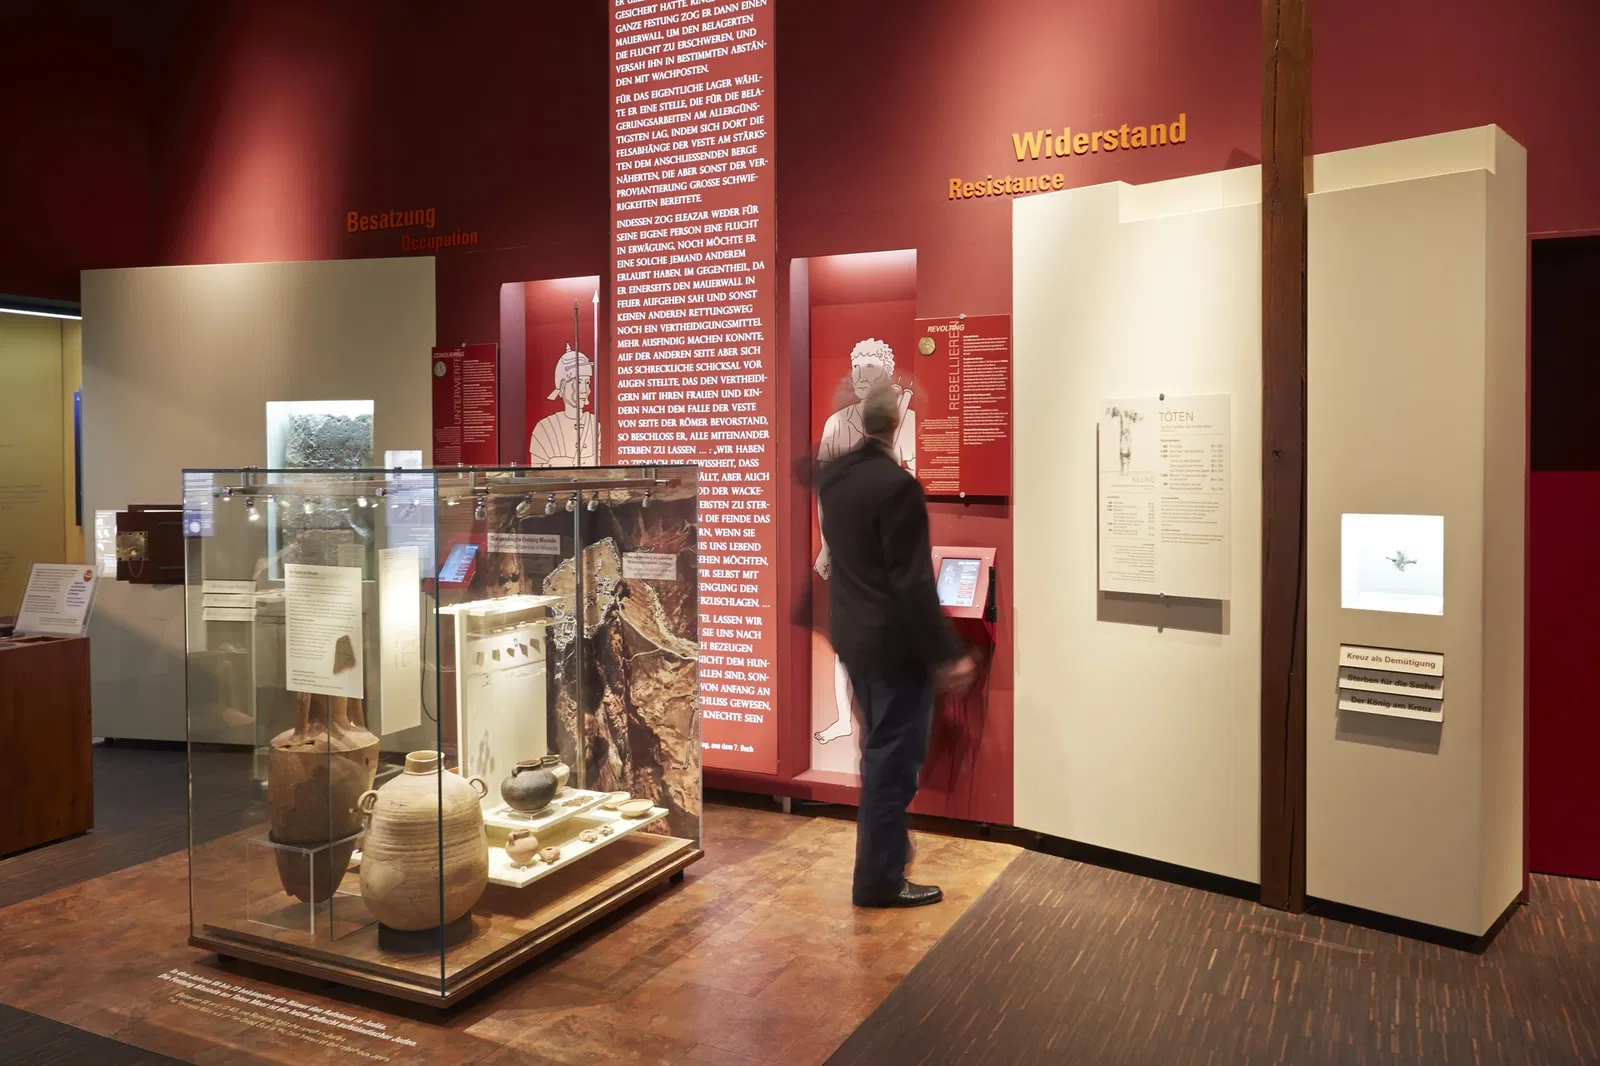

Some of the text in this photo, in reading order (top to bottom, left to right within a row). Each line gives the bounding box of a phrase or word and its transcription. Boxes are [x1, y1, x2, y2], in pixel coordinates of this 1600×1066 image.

[615, 0, 688, 19] GESICHERT HATTE.
[616, 14, 753, 47] MAUERWALL, UM DEN BELAGERTEN
[616, 40, 767, 73] VERSAH IHN IN BESTIMMTEN ABSTÄN-
[616, 74, 762, 104] FÜR DAS EIGENTLICHE LAGER WÄHL-
[616, 102, 760, 130] GERUNGSARBEITEN AM ALLERGÜNS-
[616, 130, 767, 157] FELSABHÄNGE DER VESTE AM STÄRKS-
[1012, 113, 1186, 161] Widerstand
[617, 158, 768, 184] NÄHERTEN, DIE ABER SONST DER VER-
[949, 172, 1064, 200] Resistance
[617, 194, 702, 211] RIGKEITEN BEREITETE.
[347, 208, 435, 232] Besatzung
[617, 219, 758, 242] SEINE EIGENE PERSON EINE FLUCHT
[402, 230, 478, 252] Occupation
[617, 249, 746, 268] EINE SOLCHE JEMAND ANDEREM
[629, 283, 671, 293] EINERSEITS
[674, 282, 690, 290] DEN
[693, 277, 743, 289] MAUERWALL
[746, 276, 755, 284] IN
[618, 304, 753, 321] KEINEN ANDEREN RETTUNGSWEG
[928, 324, 964, 332] REVOLTING
[618, 332, 764, 348] MEHR AUSFINDIG MACHEN KONNTE,
[618, 360, 762, 374] DAS SCHRECKLICHE SCHICKSAL VOR
[618, 388, 762, 401] GERN MIT IHREN FRAUEN UND KIN-
[638, 419, 659, 427] SEITE
[680, 417, 708, 426] RÖMER
[710, 416, 768, 426] BEVORSTAND,
[1159, 410, 1194, 422] TÖTEN
[618, 446, 651, 454] STERBEN
[668, 446, 696, 454] LASSEN
[714, 445, 733, 454] „WIR
[736, 444, 764, 453] HABEN
[732, 487, 763, 495] WACKE-
[706, 514, 770, 523] DIE FEINDE DAS
[714, 528, 755, 537] WENN SIE
[710, 542, 761, 551] UNS LEBEND
[723, 555, 768, 566] MÖCHTEN,
[712, 570, 759, 579] SELBST MIT
[714, 615, 762, 625] LASSEN WIR
[702, 628, 761, 639] SIE UNS NACH
[710, 642, 752, 652] BEZEUGEN
[1347, 652, 1369, 661] Kreuz
[1385, 656, 1436, 669] Demütigung
[700, 683, 770, 695] VON ANFANG AN
[1347, 674, 1379, 684] Sterben
[1410, 682, 1435, 690] Sache
[730, 699, 771, 710] GEWESEN,
[1367, 698, 1390, 708] König
[1408, 704, 1432, 712] Kreuz
[703, 711, 763, 723] KNECHTE SEIN
